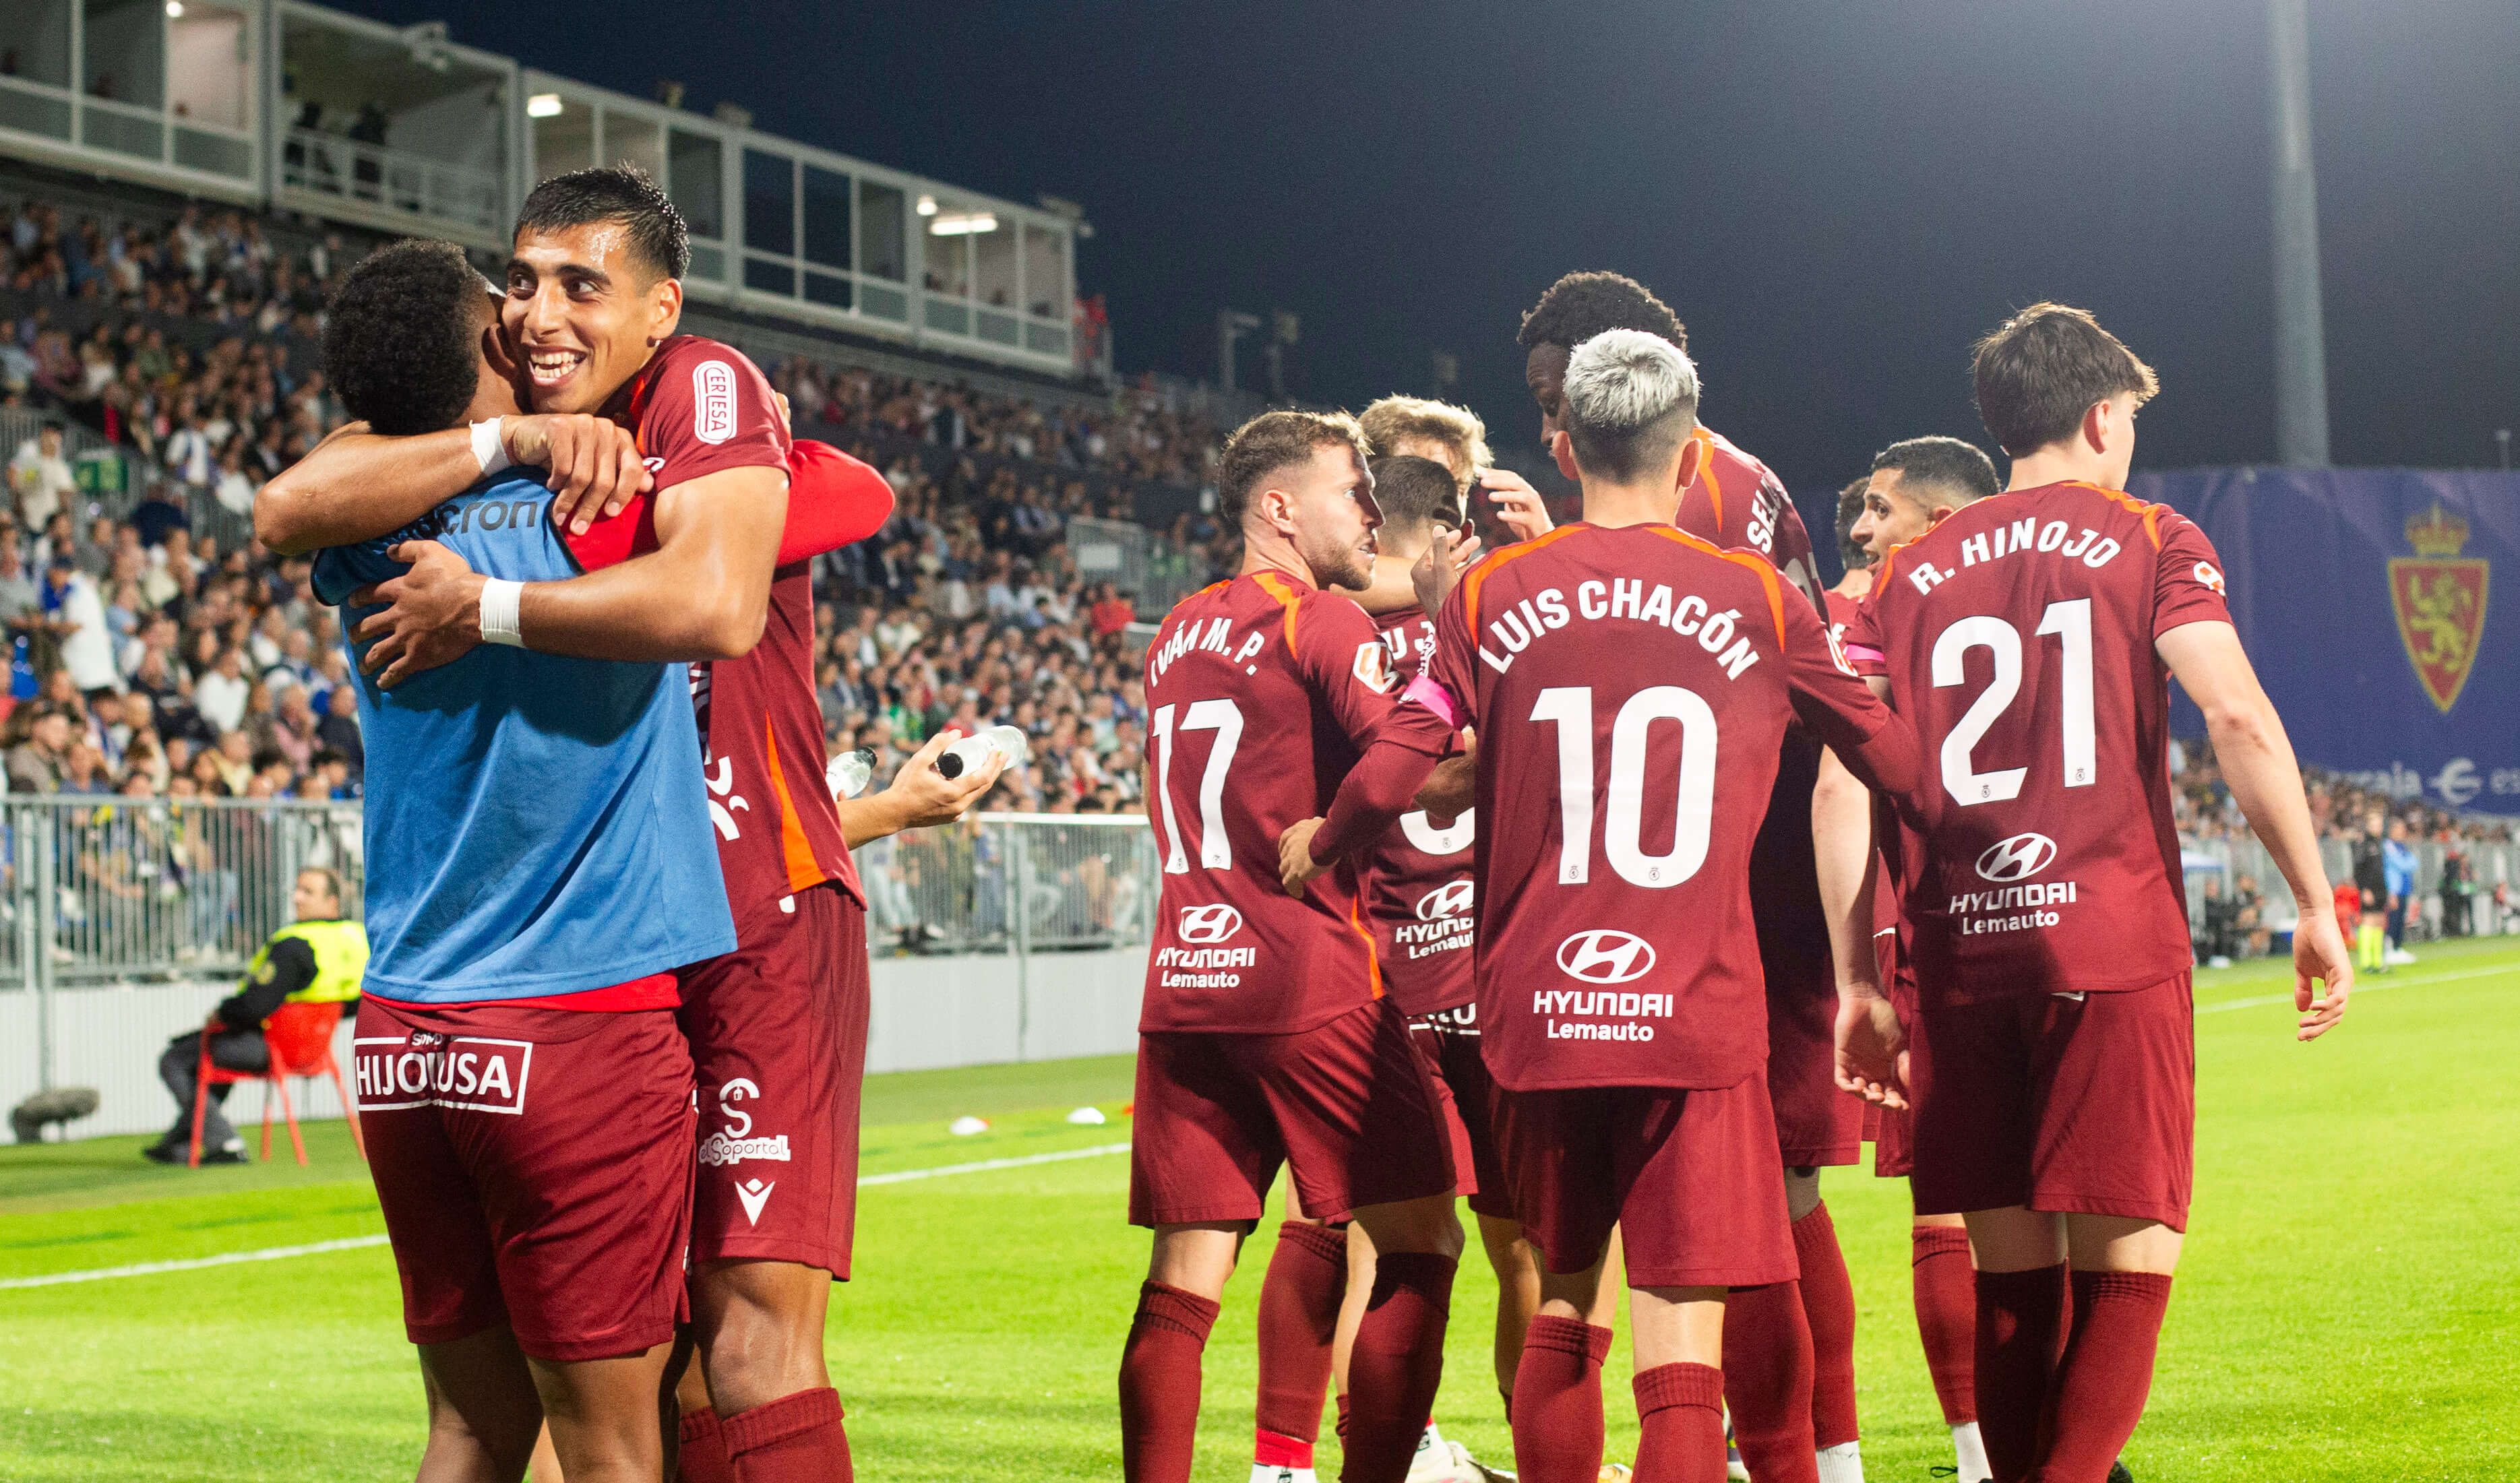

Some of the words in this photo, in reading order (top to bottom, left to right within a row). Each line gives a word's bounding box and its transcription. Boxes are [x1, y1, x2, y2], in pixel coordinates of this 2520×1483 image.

[1907, 562, 1956, 596] R.
[1961, 517, 2120, 568] HINOJO
[1479, 588, 1570, 674] LUIS
[1578, 577, 1760, 681] CHACÓN
[1150, 619, 1204, 687] IVÁN
[1199, 617, 1233, 656] M.
[1233, 631, 1264, 676] P.
[1932, 598, 2096, 806] 21
[1153, 699, 1243, 873] 17
[1529, 686, 1718, 888] 10
[1949, 881, 2077, 914] HYUNDAI
[1396, 917, 1473, 943] HYUND
[1963, 910, 2060, 935] Lemauto
[1155, 947, 1256, 968] HYUNDAI
[1161, 970, 1240, 988] Lemauto
[1533, 990, 1673, 1017] HYUNDAI
[1547, 1019, 1655, 1042] Lemauto
